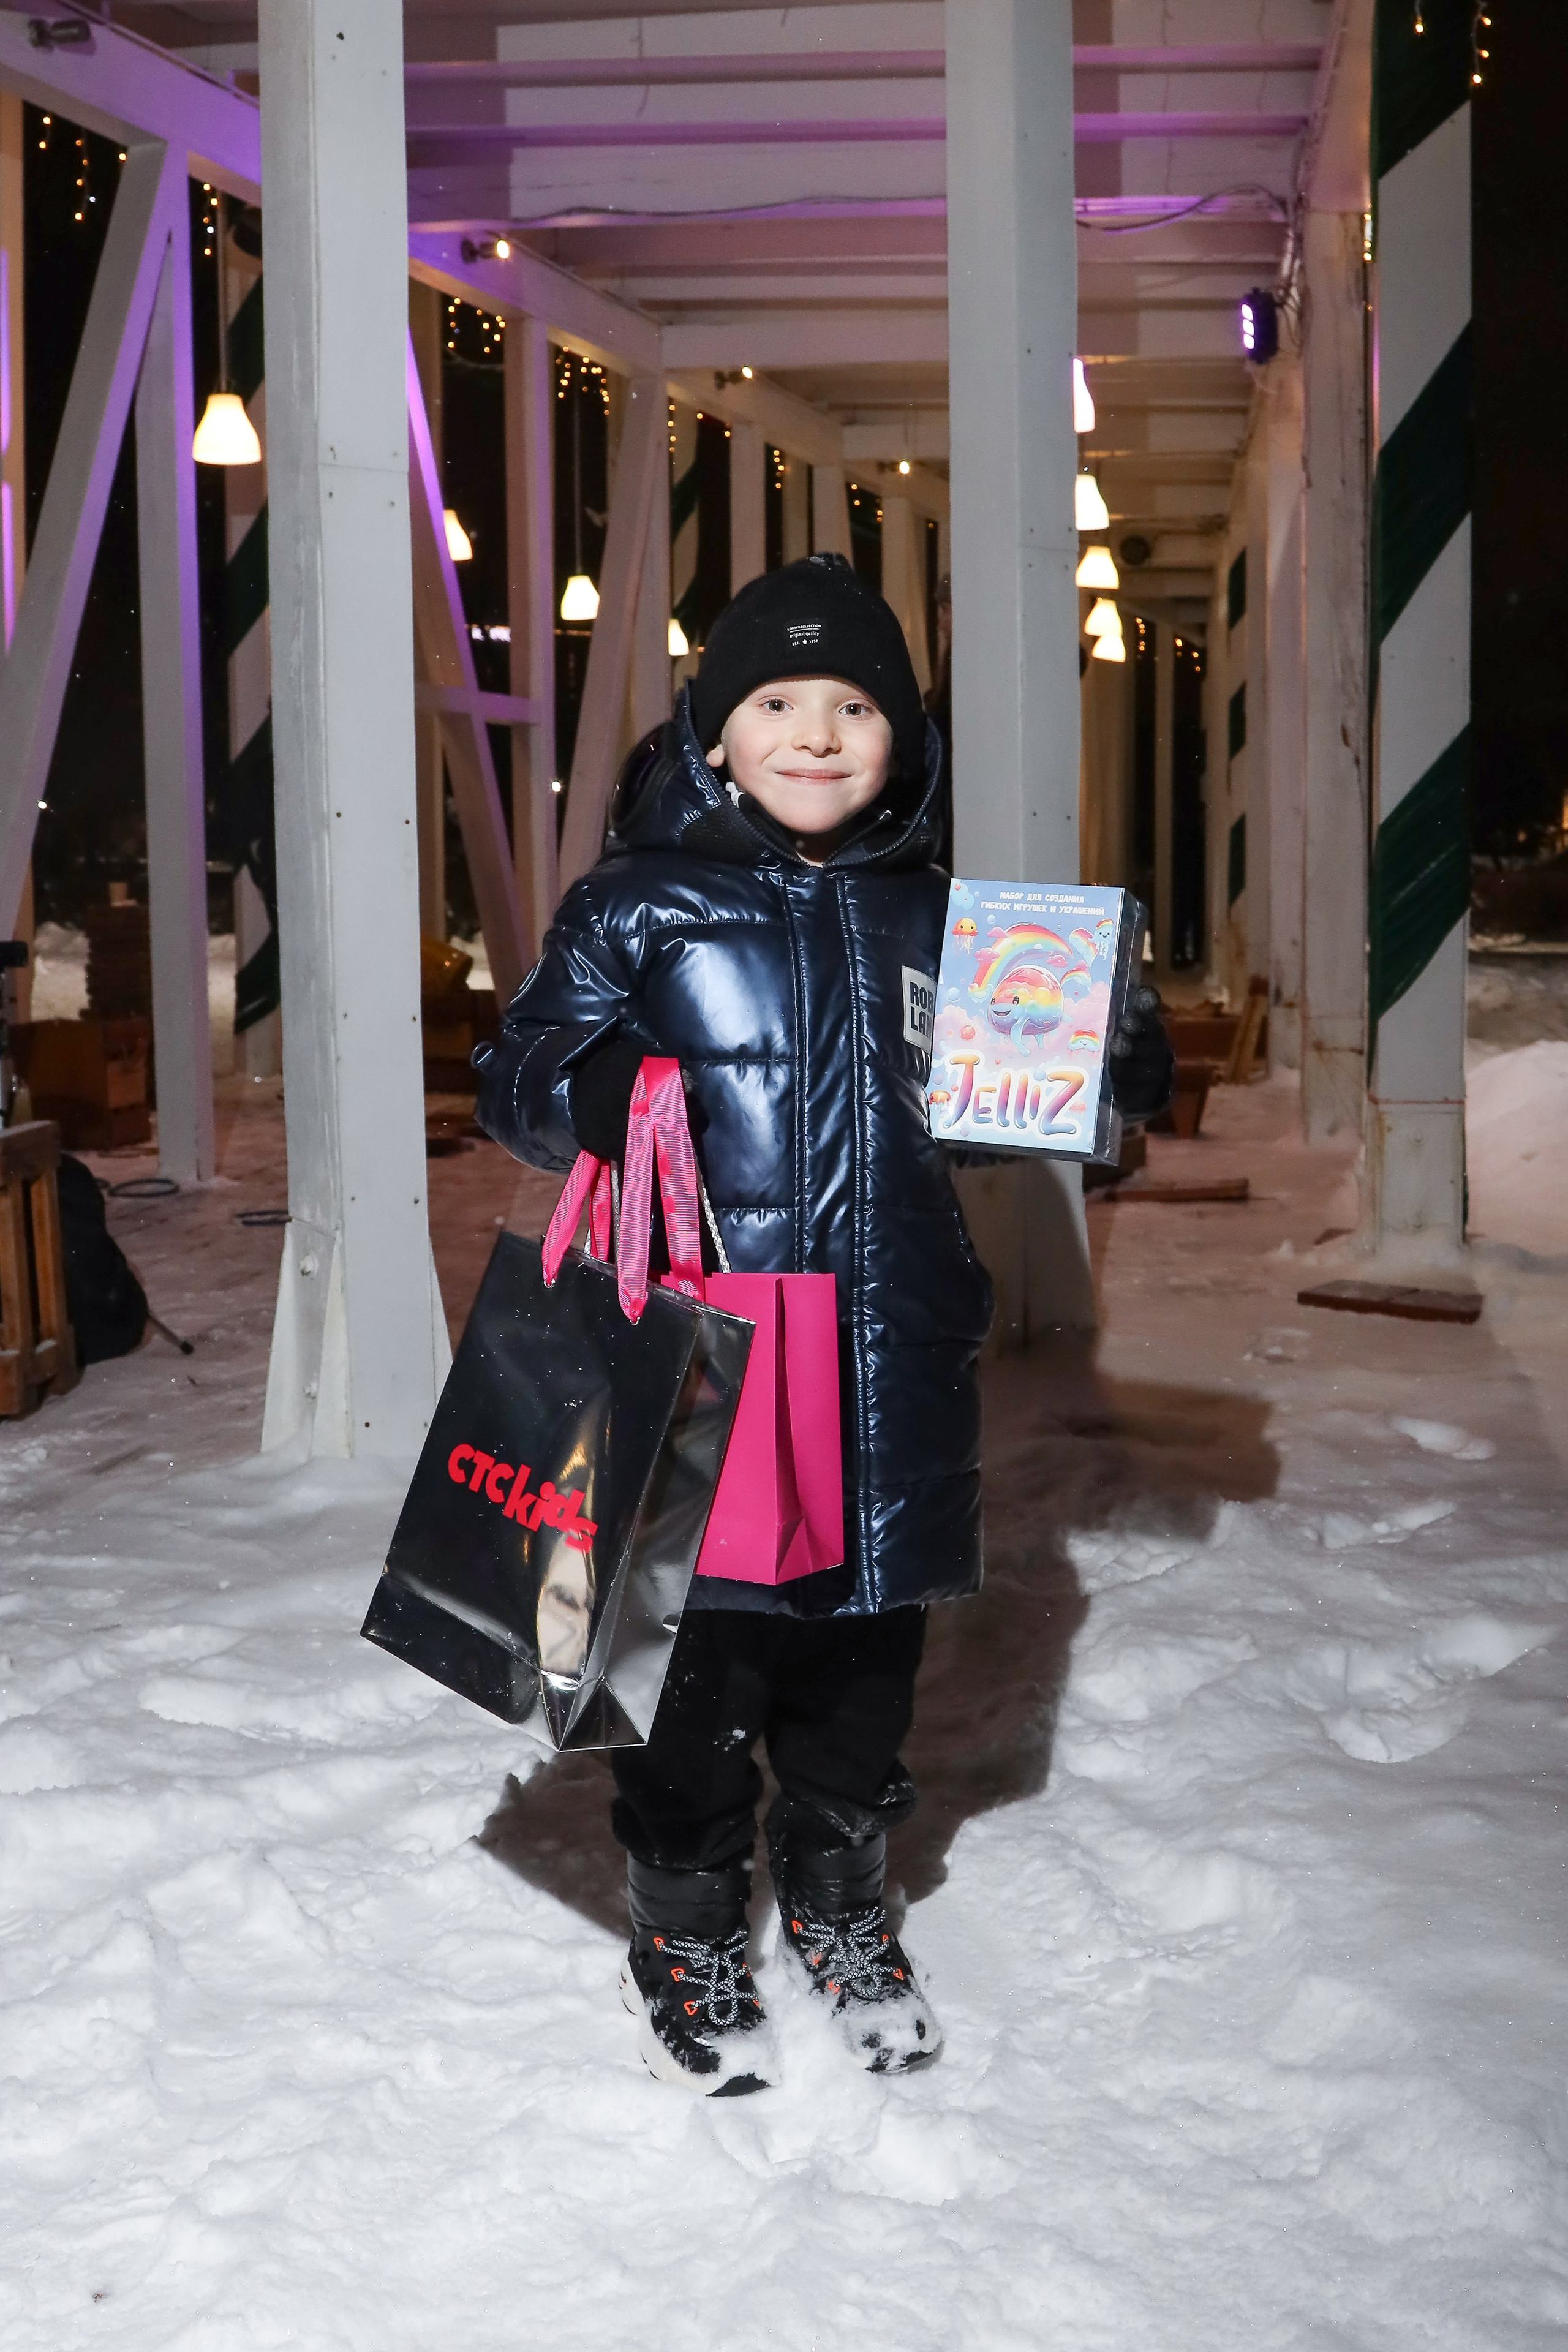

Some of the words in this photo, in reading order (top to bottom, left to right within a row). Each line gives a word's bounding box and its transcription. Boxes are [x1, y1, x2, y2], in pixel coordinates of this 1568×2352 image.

[1000, 891, 1024, 900] НАБОР
[1045, 894, 1084, 903] СОЗДАНИЯ
[981, 901, 1011, 910] ГИБКИХ
[1013, 903, 1047, 913] ИГРУШЕК
[1058, 907, 1105, 916] УКРАШЕНИЙ
[910, 981, 934, 1014] ROB
